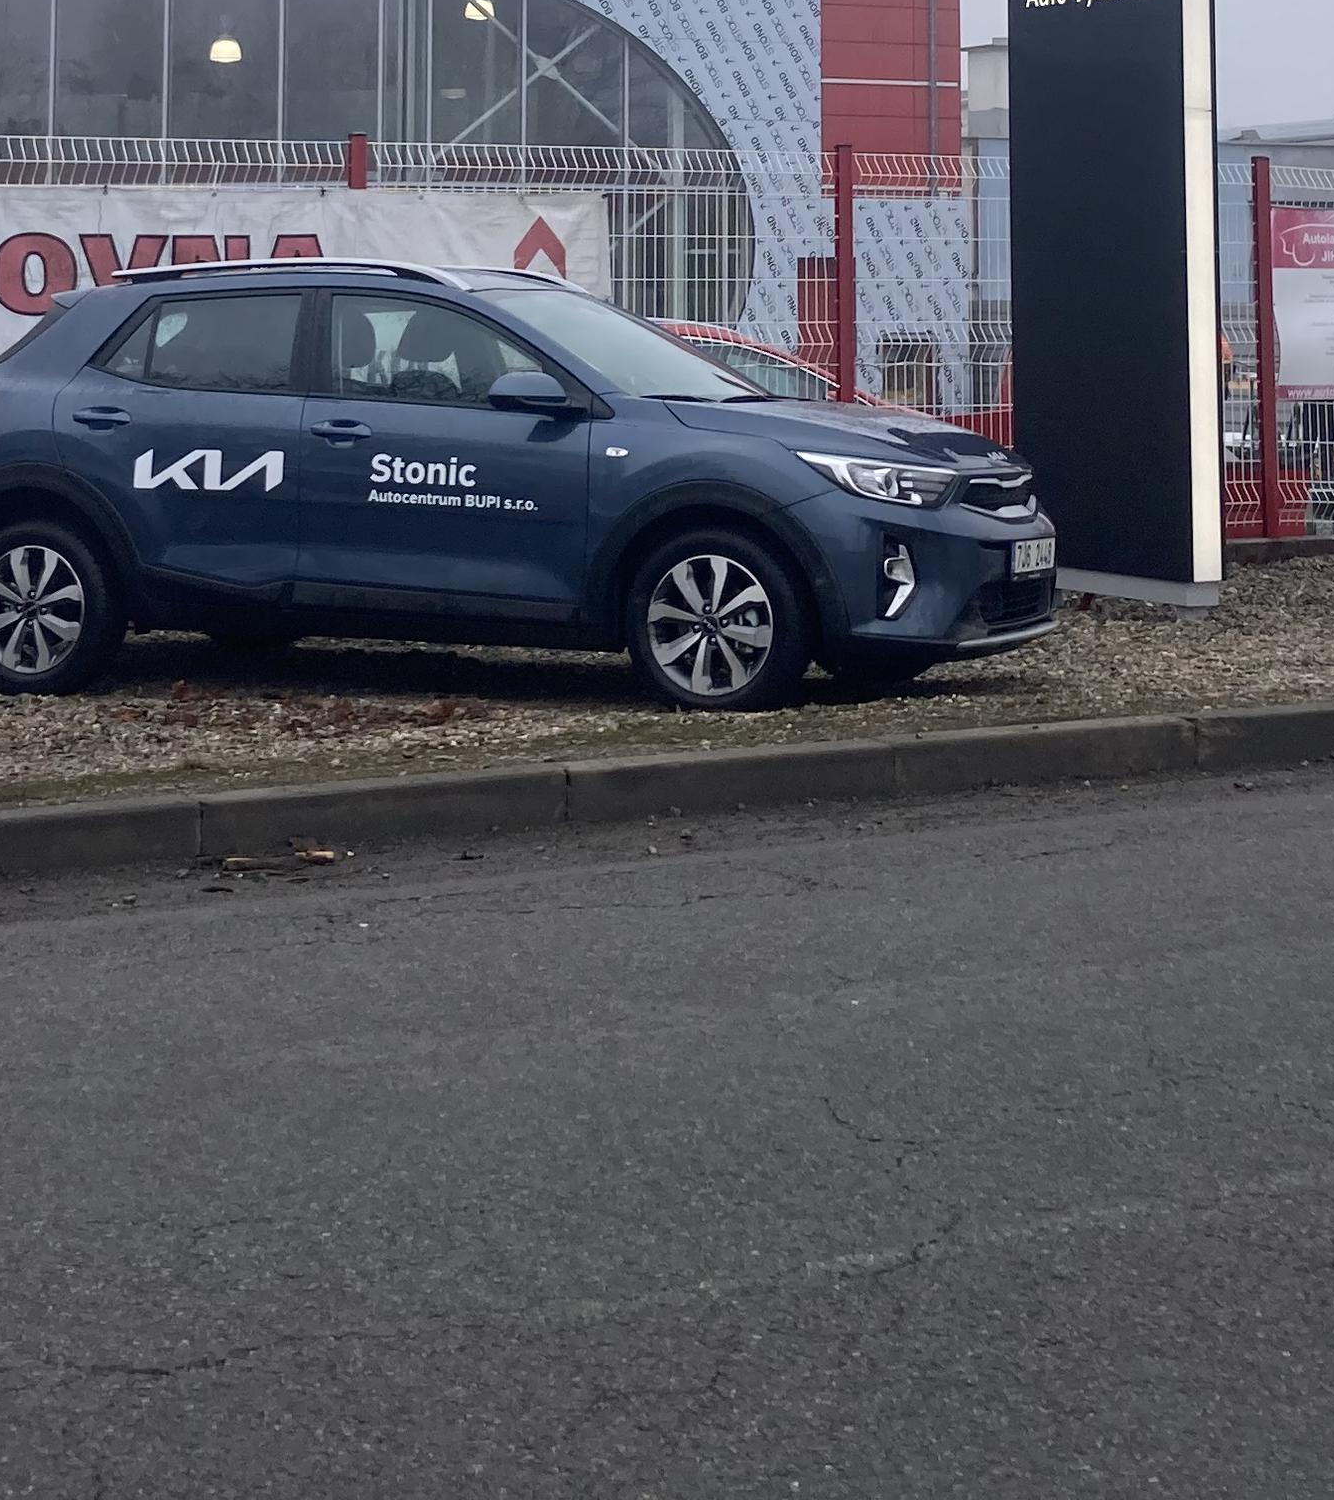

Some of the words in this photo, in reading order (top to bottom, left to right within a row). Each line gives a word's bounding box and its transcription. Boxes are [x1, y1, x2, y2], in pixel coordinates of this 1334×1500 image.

[133, 448, 285, 493] KIA
[369, 453, 477, 487] Stonic
[368, 489, 461, 507] Autocentrum
[464, 494, 501, 509] BUPI
[504, 498, 539, 511] s.r.o.
